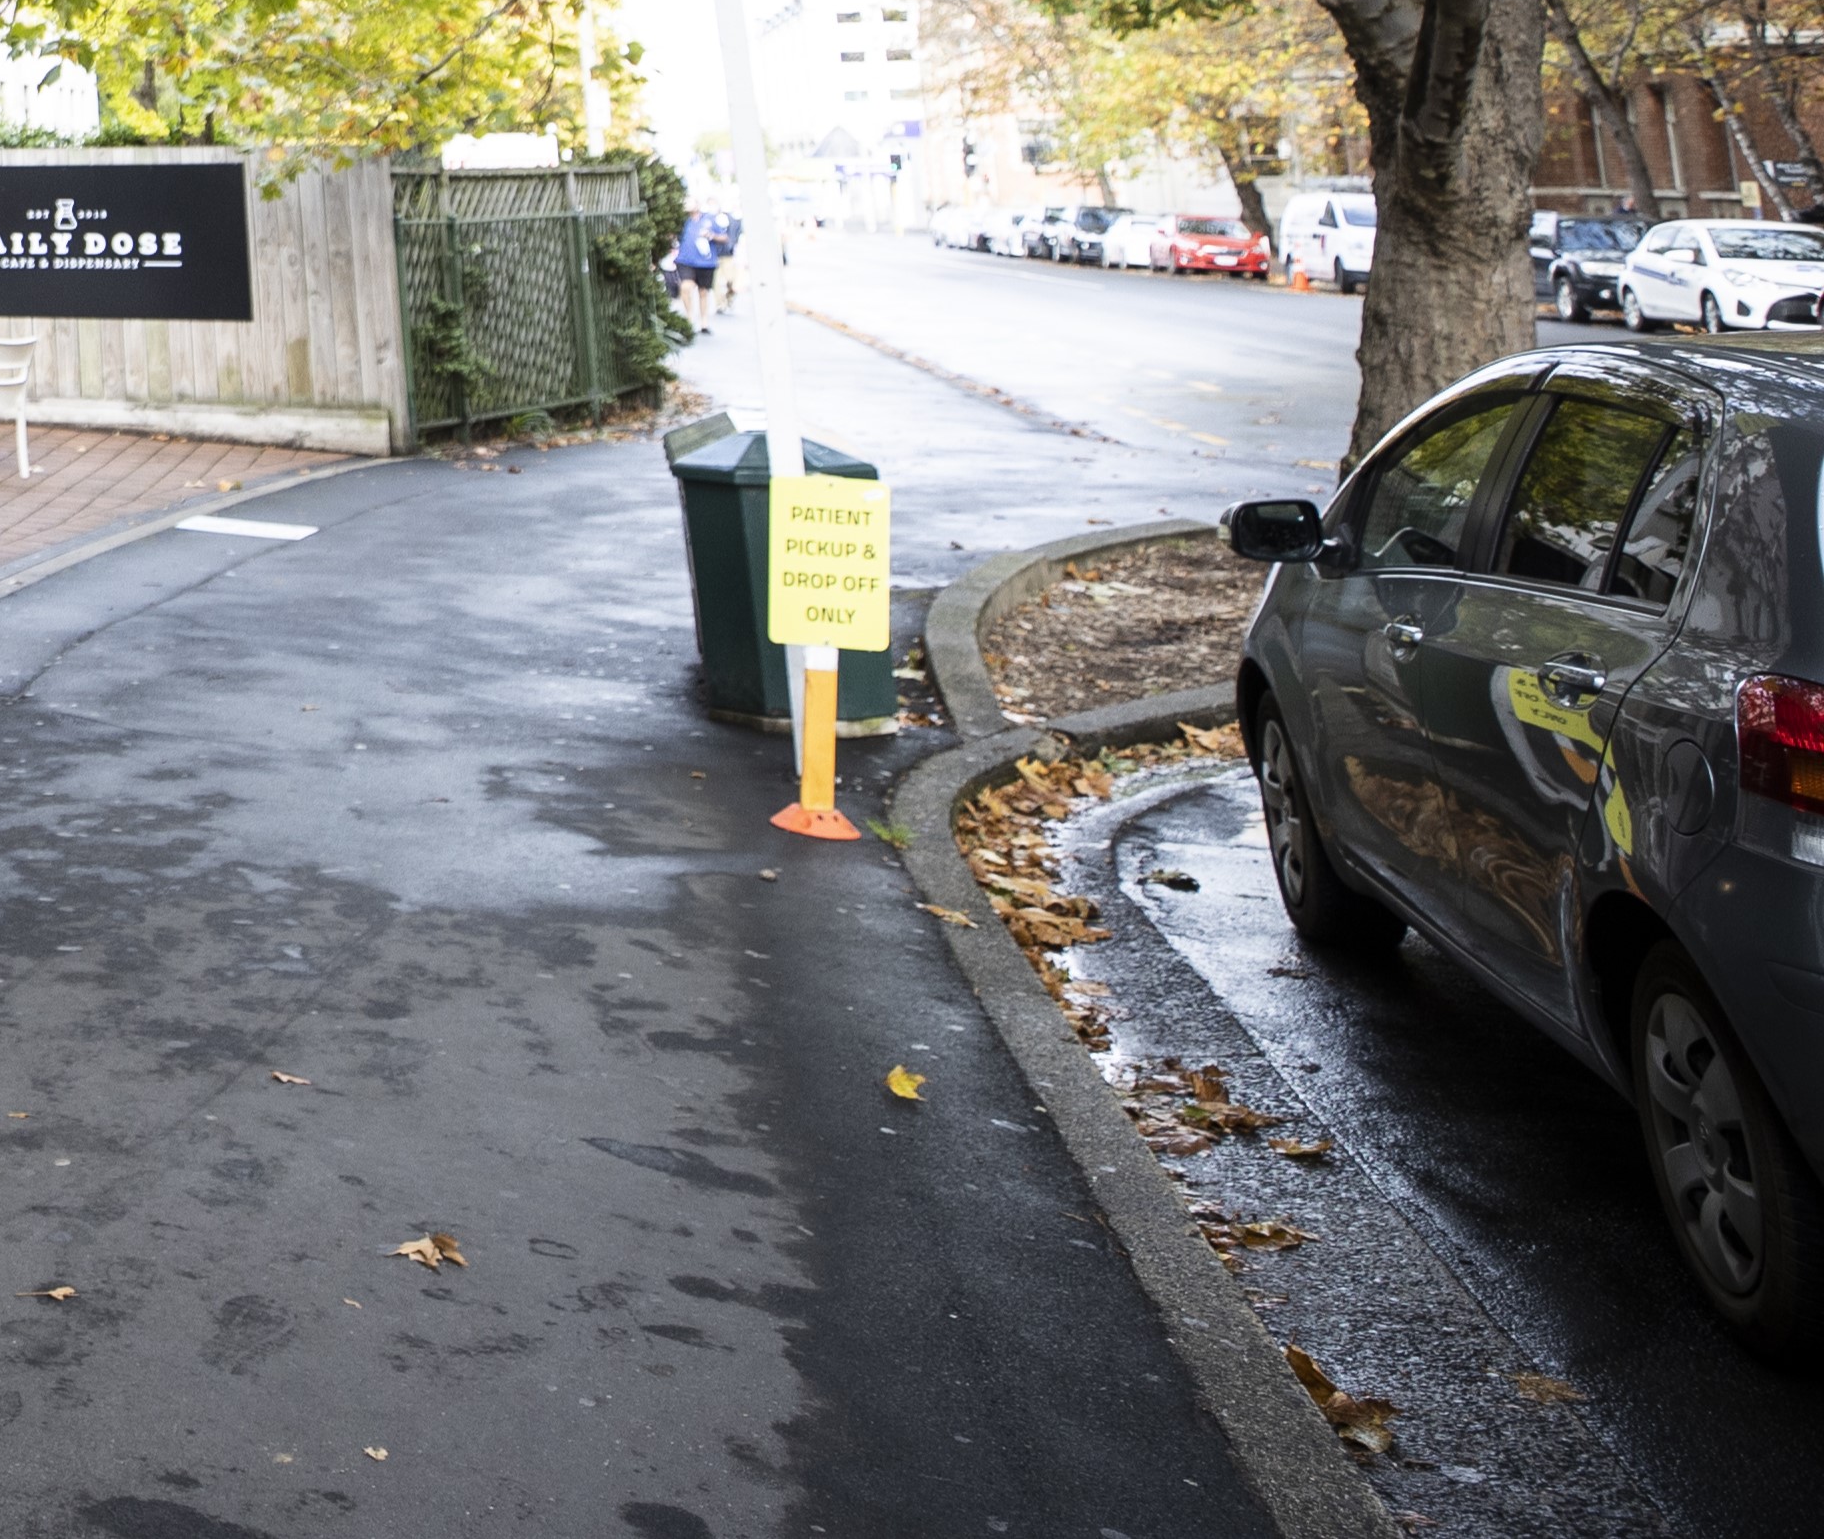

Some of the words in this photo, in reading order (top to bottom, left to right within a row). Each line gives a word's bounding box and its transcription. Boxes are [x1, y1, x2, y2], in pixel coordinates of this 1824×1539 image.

[83, 232, 182, 255] DOSE
[38, 257, 49, 269] &
[53, 258, 140, 270] DISPENSARY
[792, 506, 872, 525] PATIENT
[787, 538, 857, 557] PICKUP
[863, 544, 875, 560] &
[783, 571, 837, 589] DROP
[843, 576, 880, 592] OFF
[806, 605, 856, 624] ONLY
